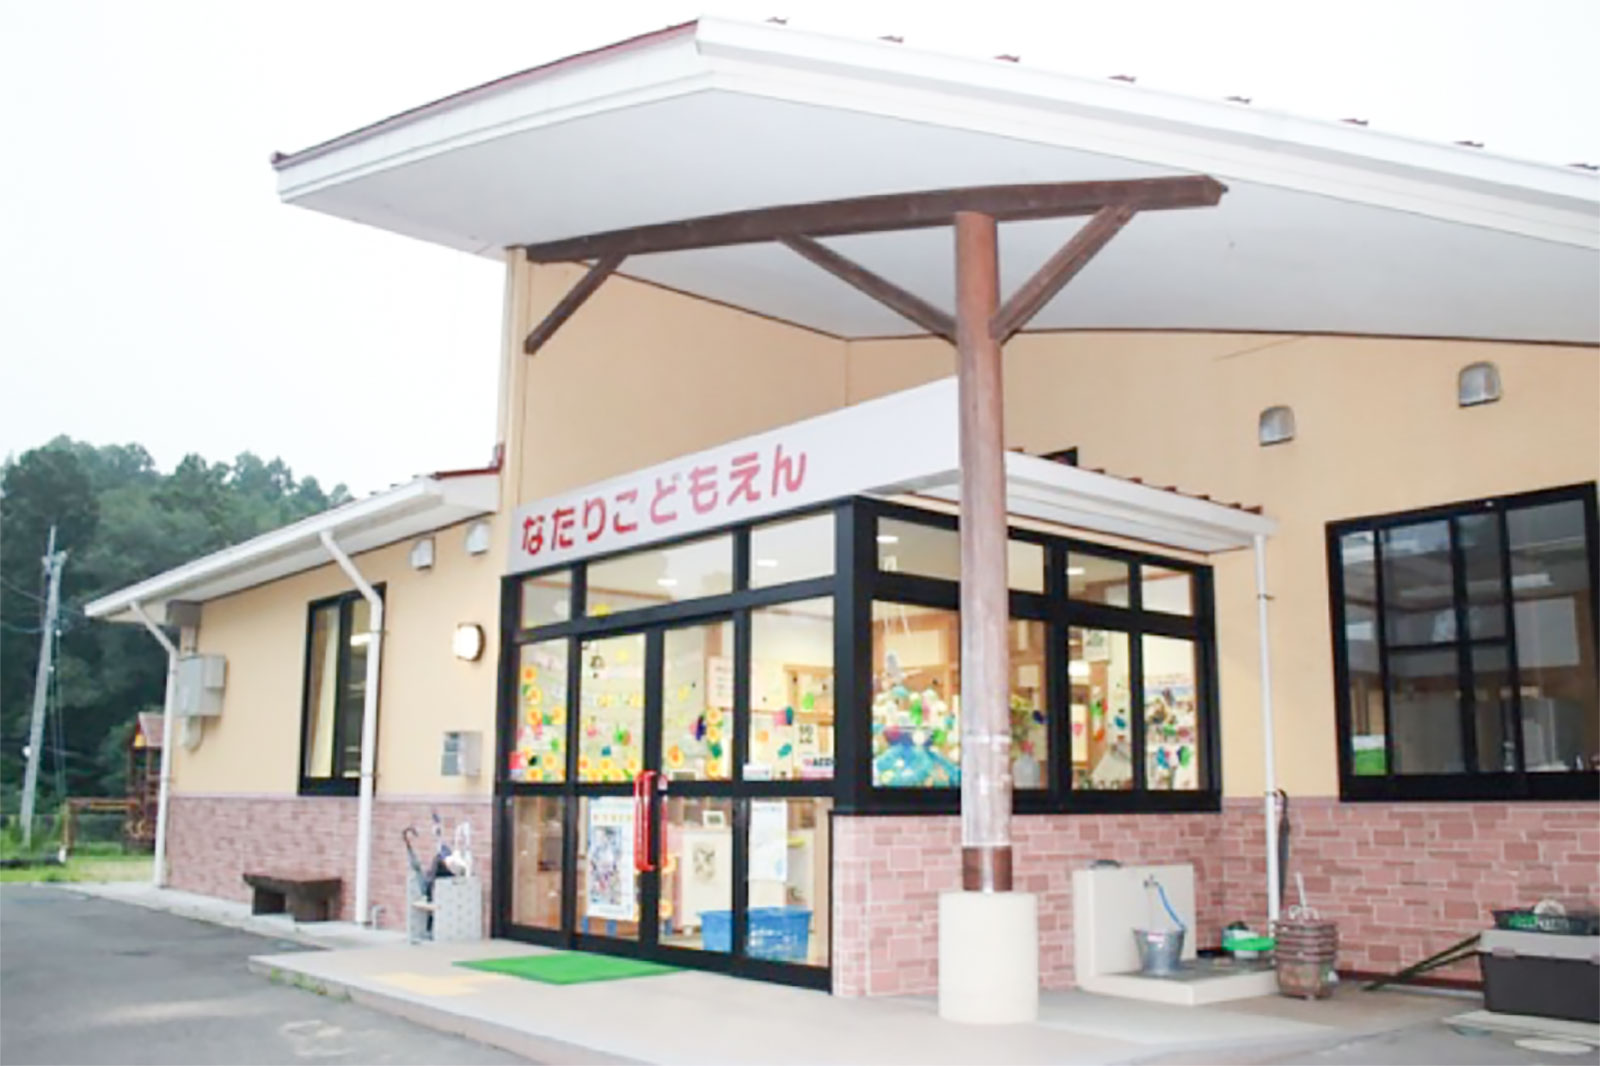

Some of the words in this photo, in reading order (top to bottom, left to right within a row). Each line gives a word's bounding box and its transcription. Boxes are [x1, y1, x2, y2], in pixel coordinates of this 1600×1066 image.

[521, 444, 807, 555] なたりこどもえん
